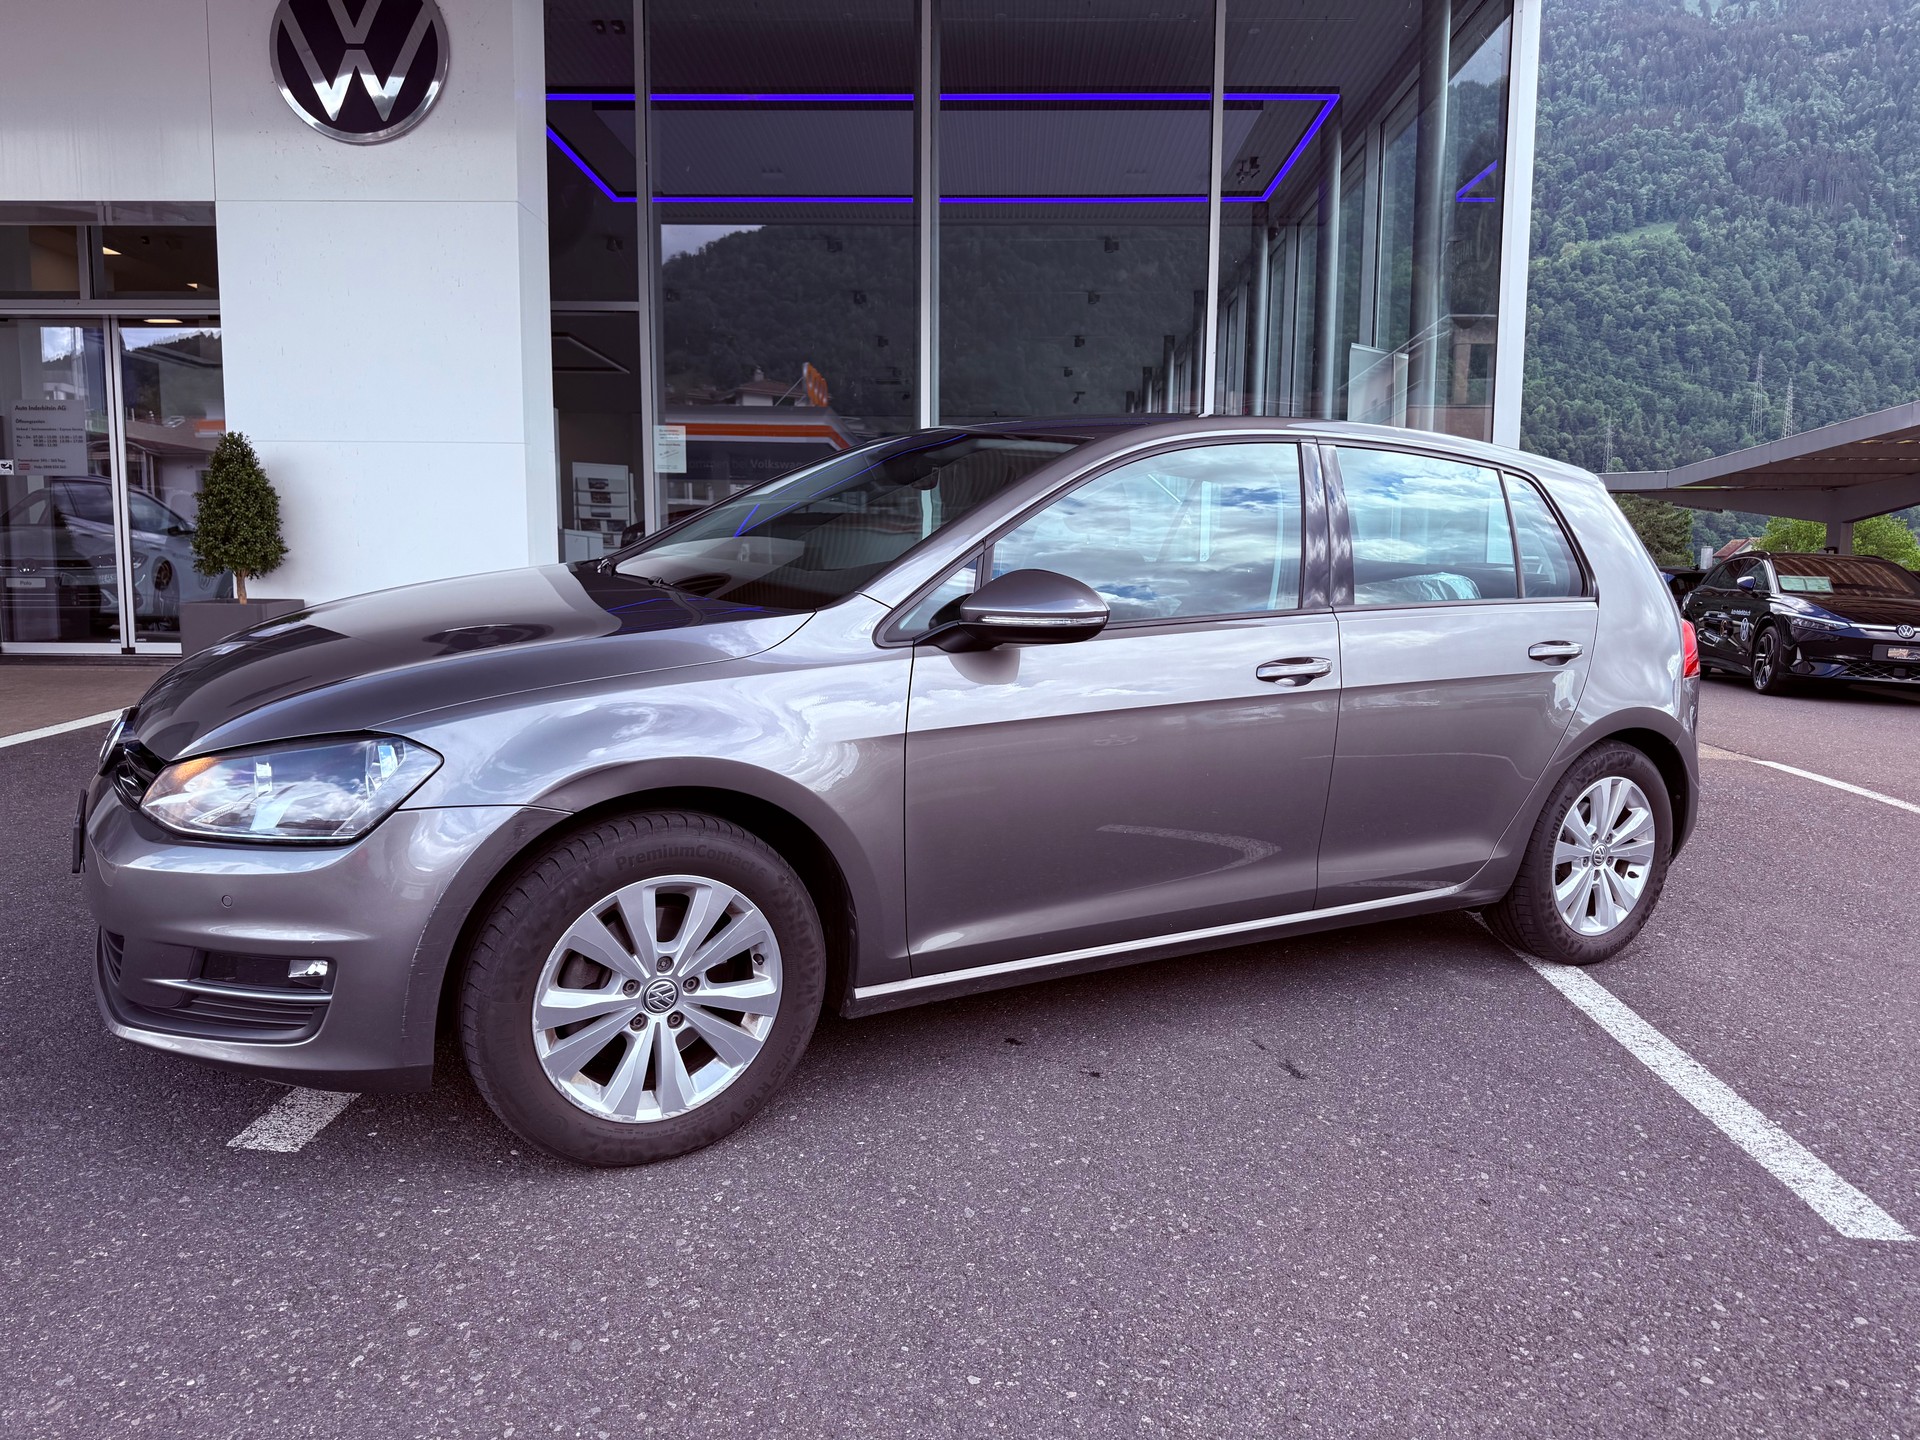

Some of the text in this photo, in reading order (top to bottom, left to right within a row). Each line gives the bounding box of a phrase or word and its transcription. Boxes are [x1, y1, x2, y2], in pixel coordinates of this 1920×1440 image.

[615, 844, 769, 881] PremiumContact 6
[769, 1024, 806, 1080] 205/55
